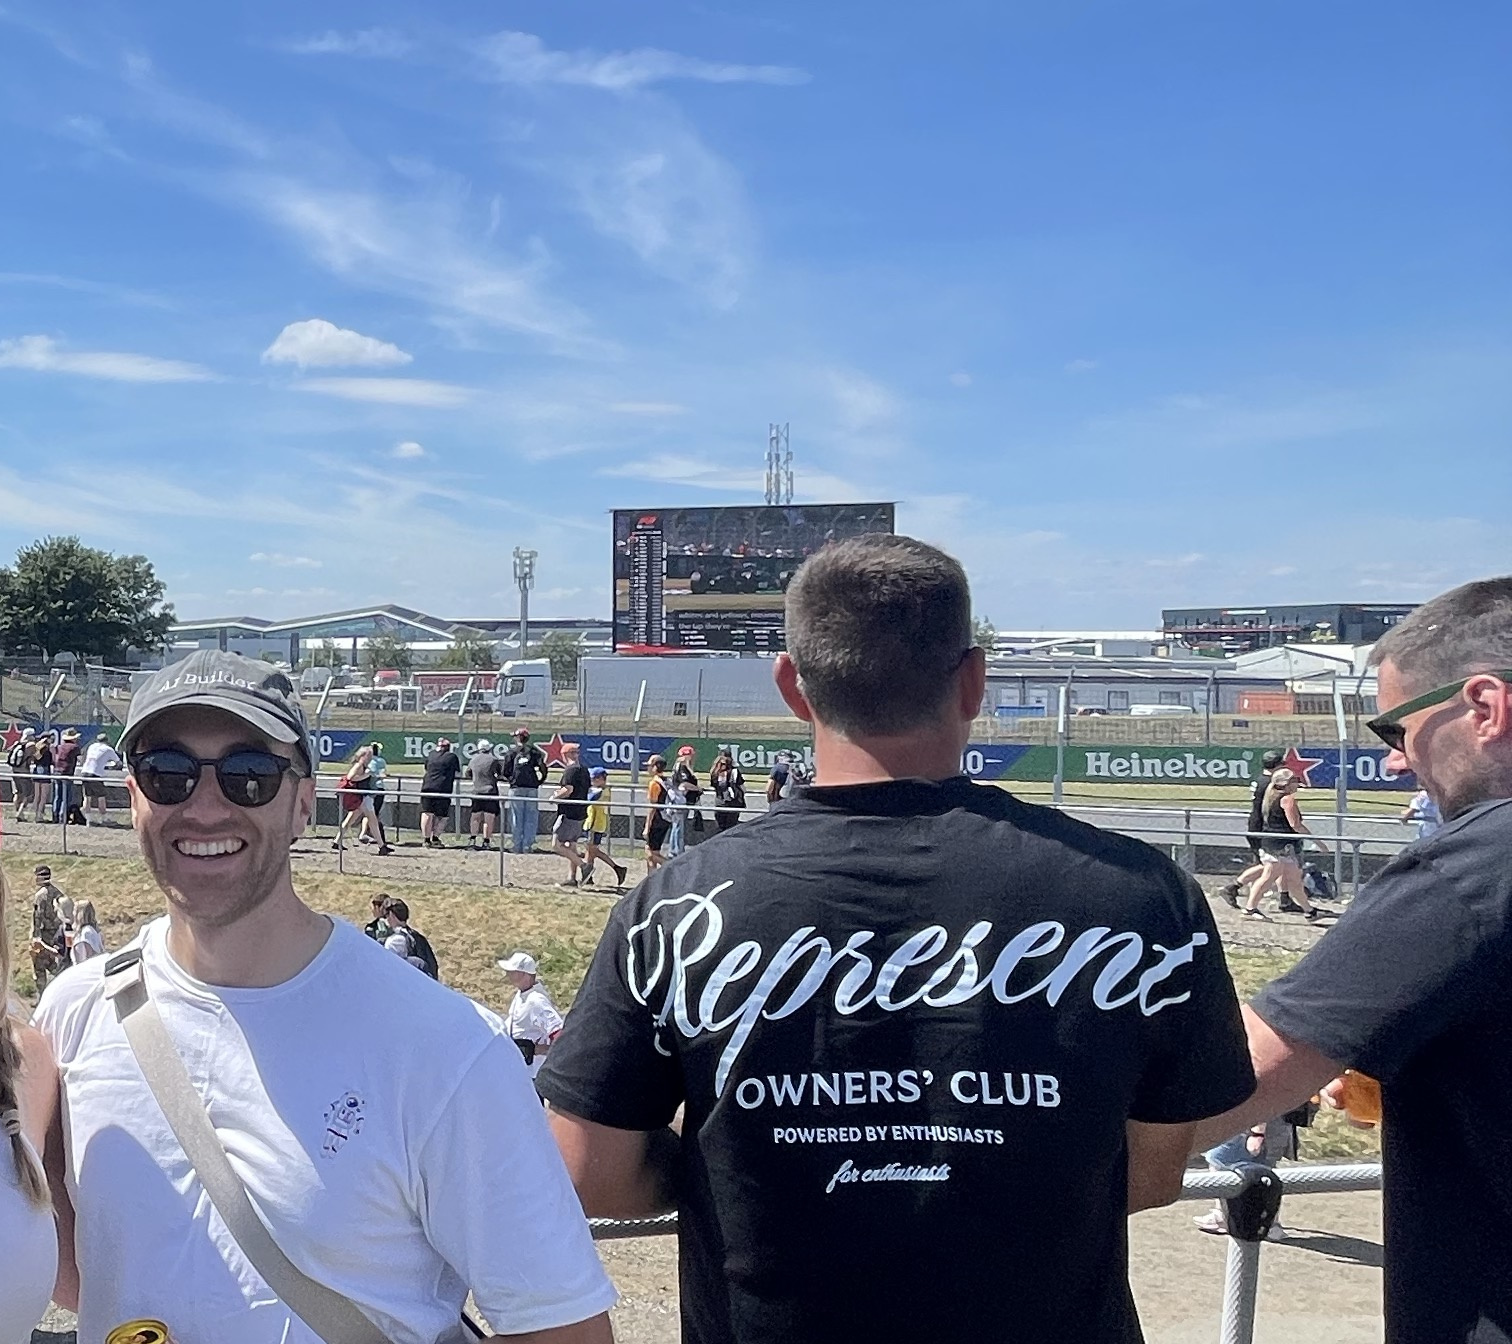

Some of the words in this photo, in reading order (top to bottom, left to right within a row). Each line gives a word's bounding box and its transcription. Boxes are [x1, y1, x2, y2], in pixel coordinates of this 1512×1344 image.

[158, 677, 180, 693] AI
[184, 671, 256, 691] Builder
[627, 880, 1209, 1098] Represent
[950, 1070, 1061, 1108] CLUB
[773, 1126, 862, 1145] POWERED
[865, 1126, 888, 1143] BY
[892, 1126, 1005, 1145] ENTHUSIASTS
[826, 1159, 860, 1193] for
